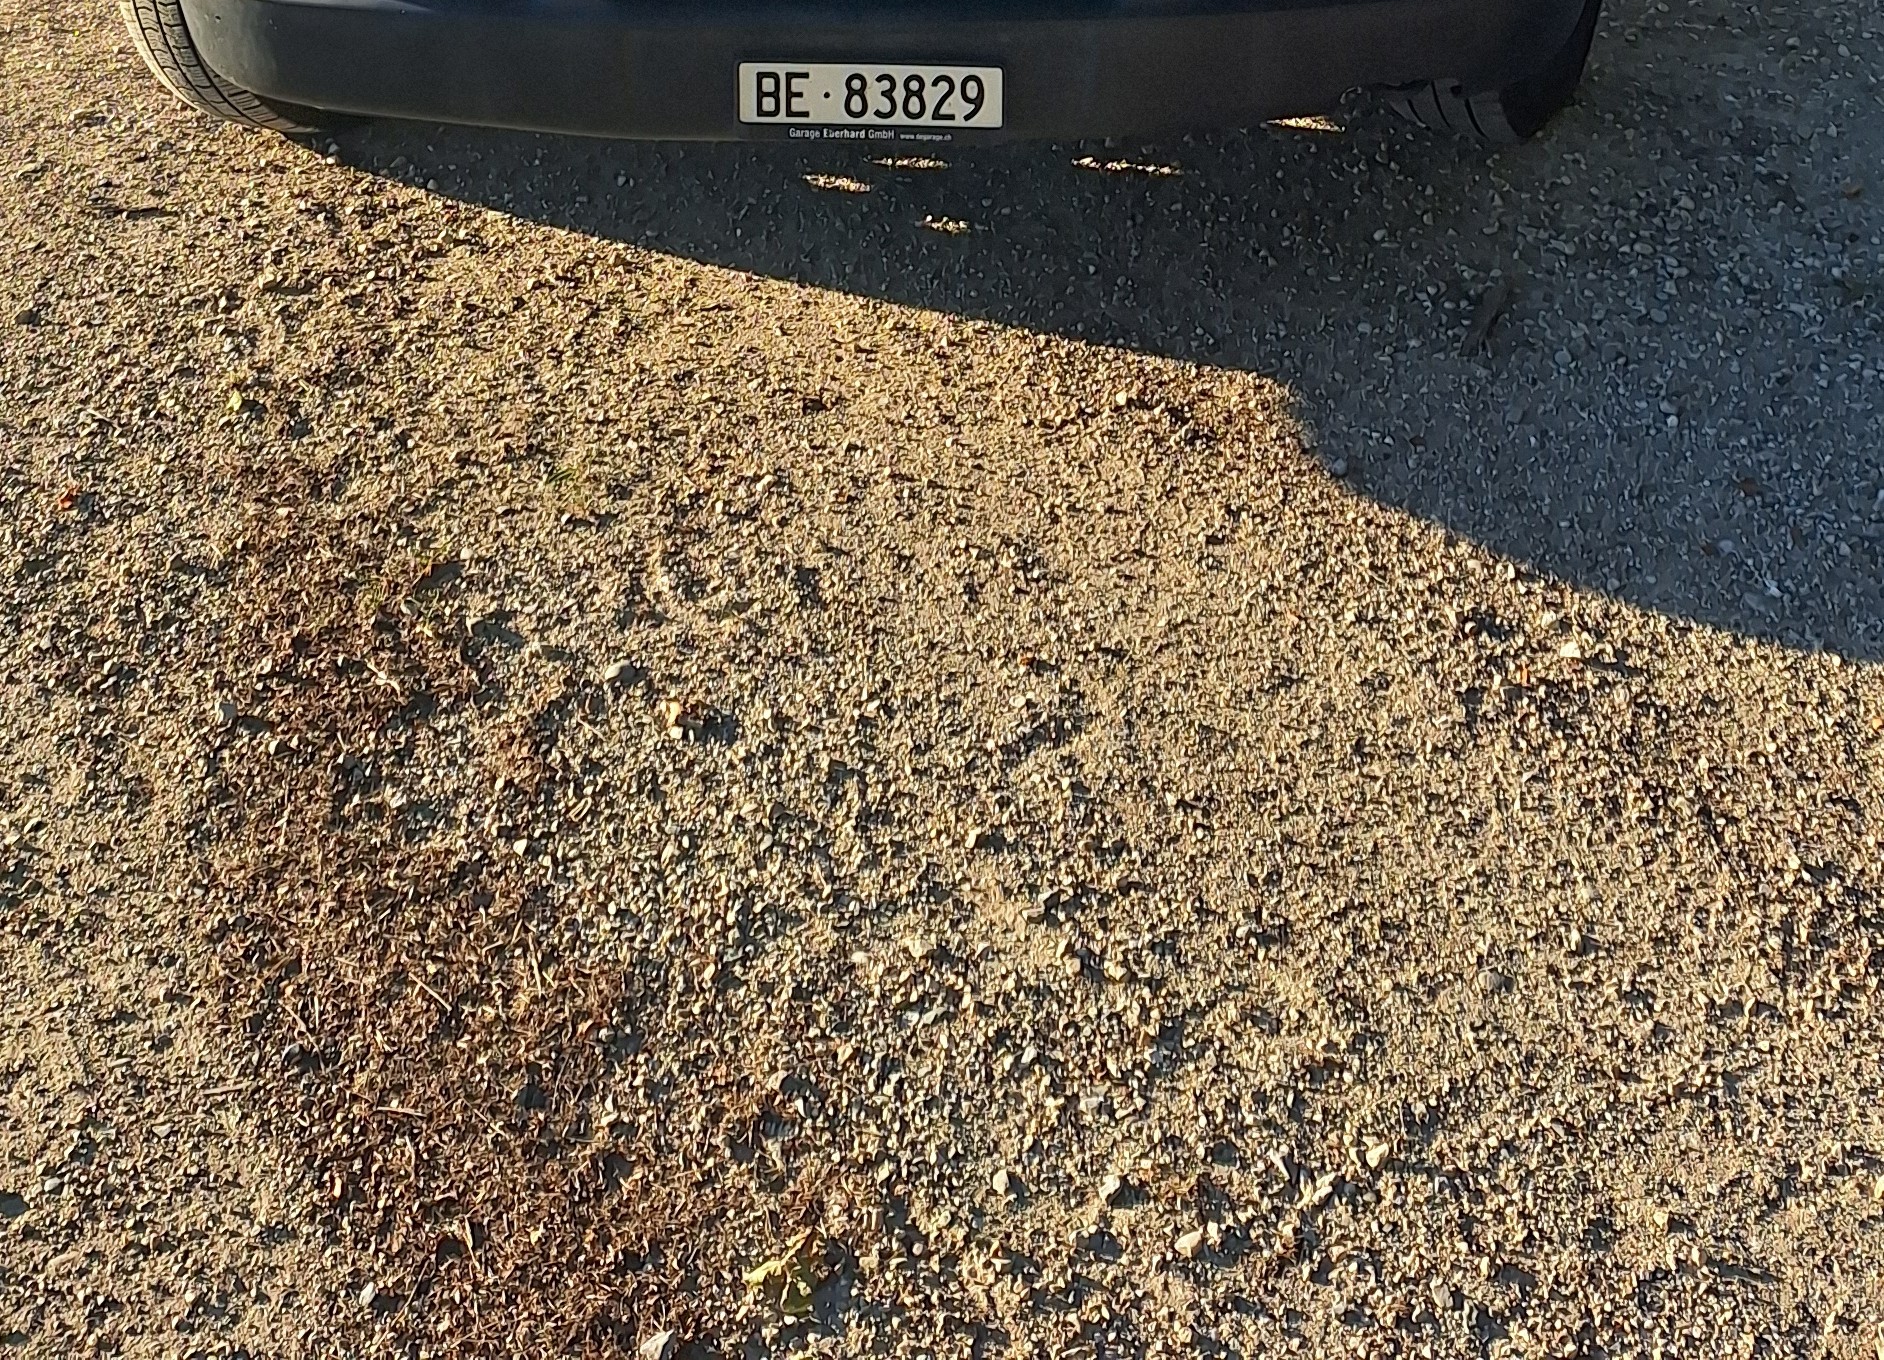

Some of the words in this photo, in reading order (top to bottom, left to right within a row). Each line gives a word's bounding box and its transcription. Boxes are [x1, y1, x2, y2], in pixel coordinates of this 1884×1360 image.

[756, 71, 811, 118] BE
[843, 72, 985, 122] 83829
[789, 127, 821, 140] Garage
[822, 128, 866, 139] Eberhard
[867, 128, 895, 140] GmbH
